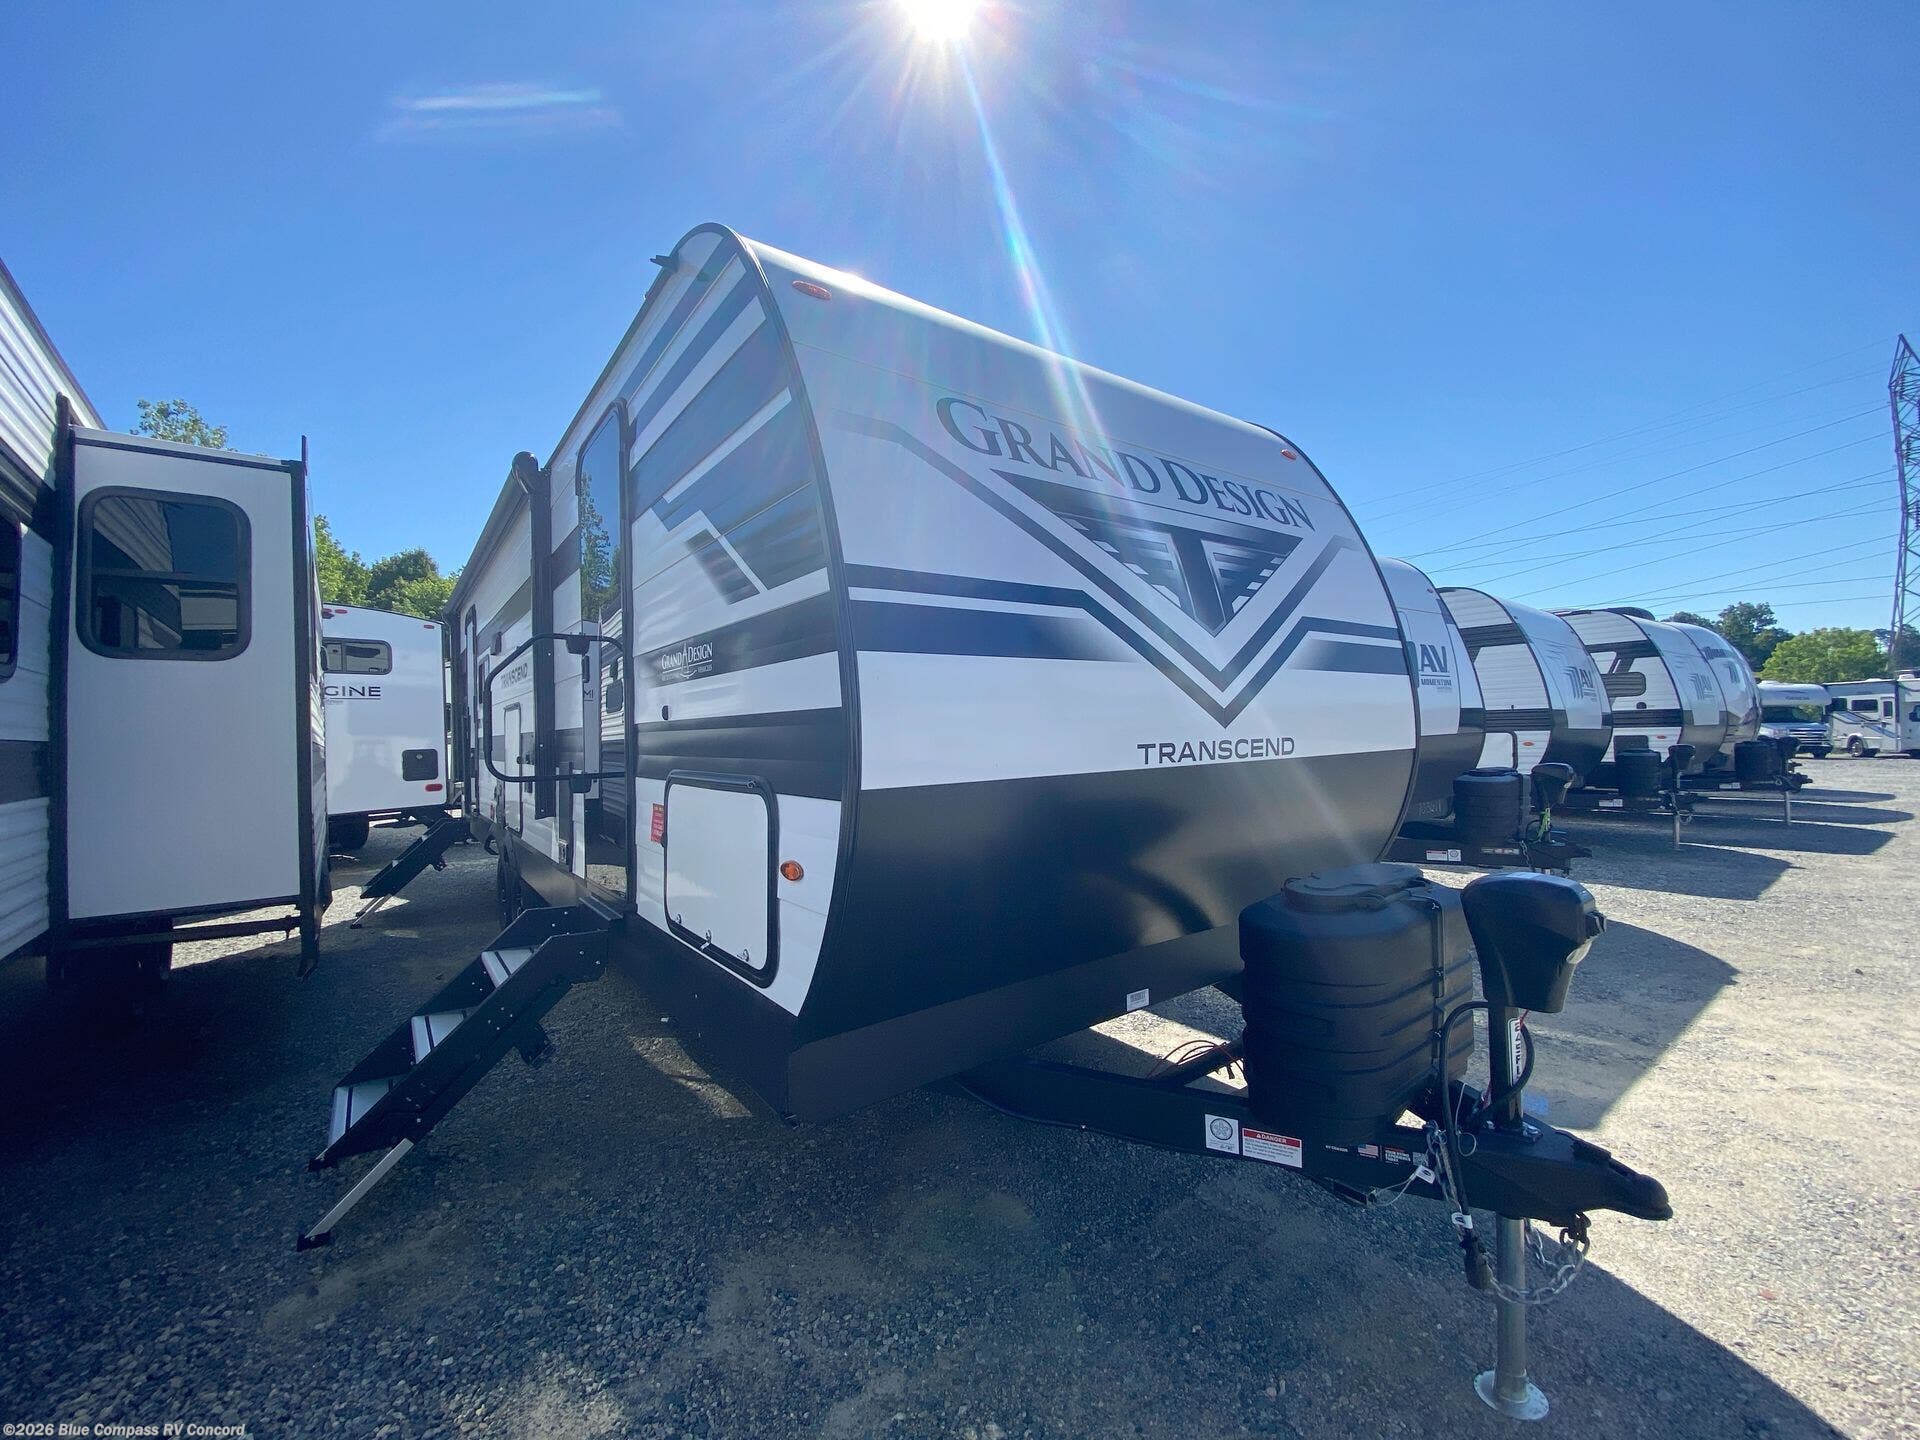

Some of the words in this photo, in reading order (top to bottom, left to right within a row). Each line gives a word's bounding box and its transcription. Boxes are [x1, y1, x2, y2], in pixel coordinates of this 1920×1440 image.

[936, 397, 1162, 494] GRAND
[1155, 457, 1316, 532] DESIGN
[661, 652, 682, 670] GRAND
[687, 642, 713, 662] DESIGN
[1137, 737, 1295, 765] TRANSCEND
[1261, 1133, 1287, 1144] DANGER
